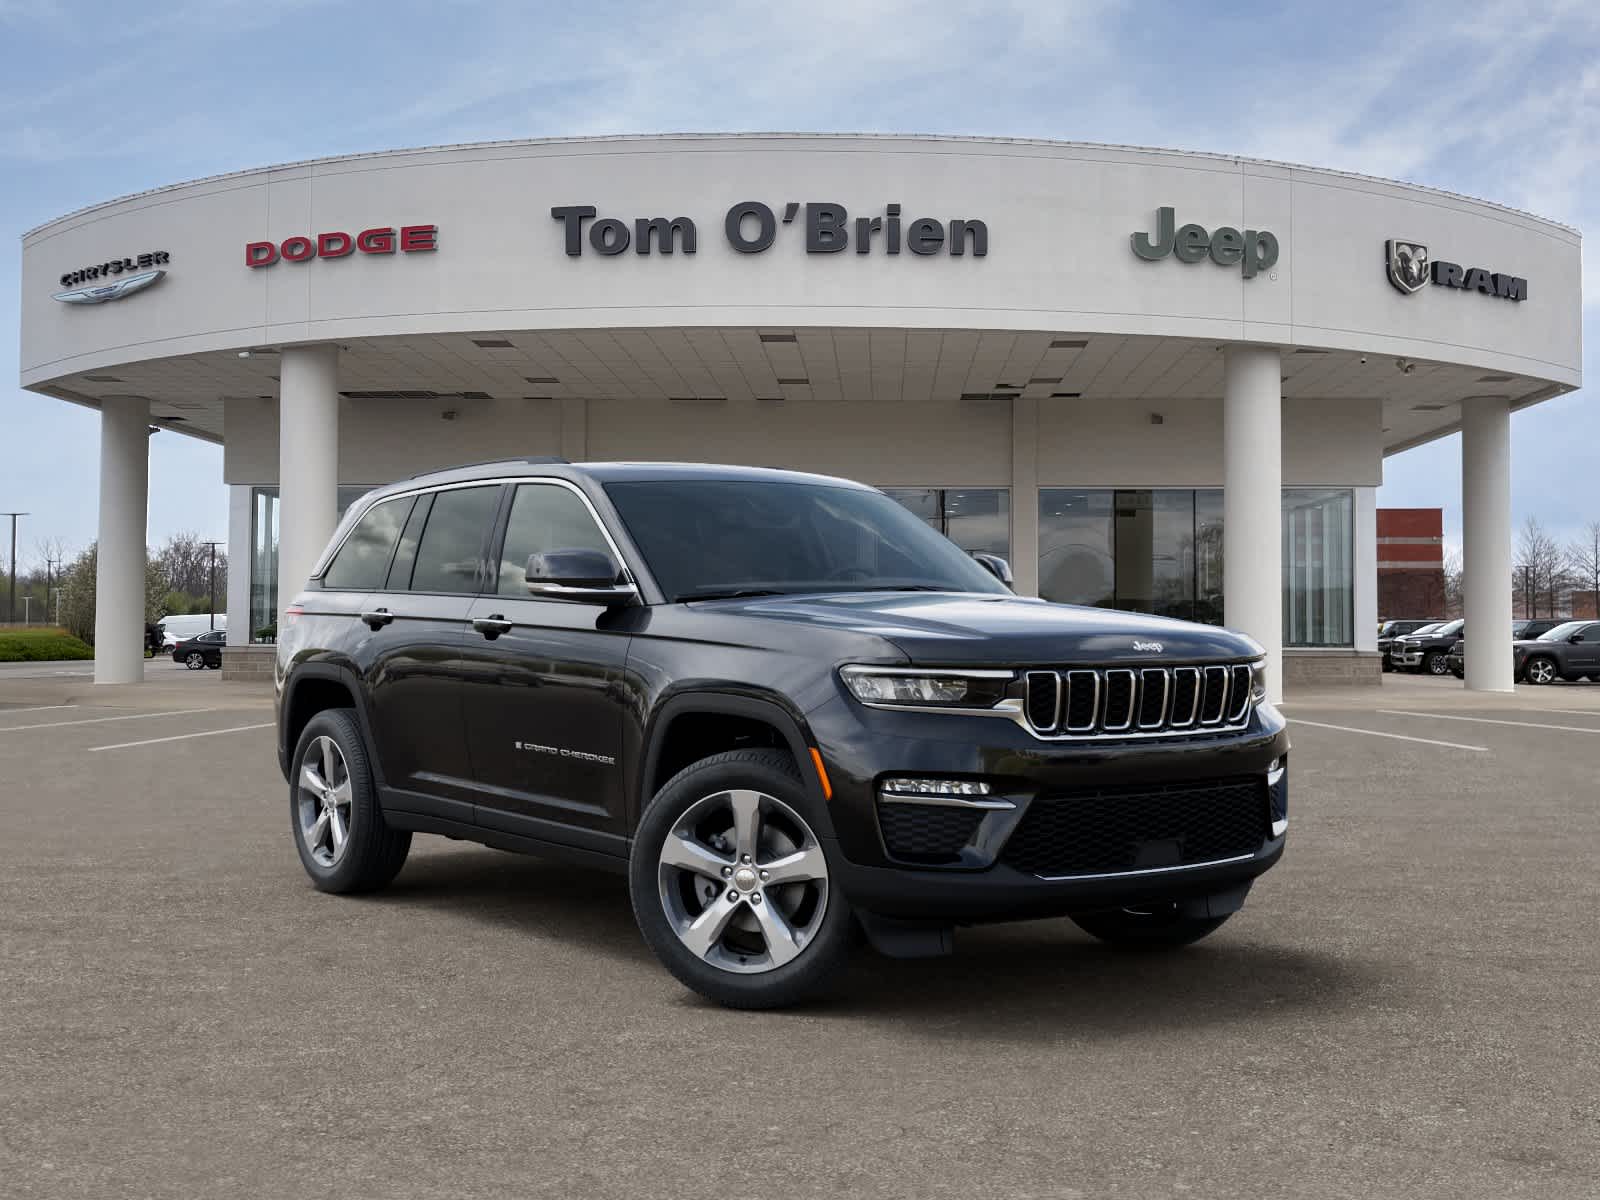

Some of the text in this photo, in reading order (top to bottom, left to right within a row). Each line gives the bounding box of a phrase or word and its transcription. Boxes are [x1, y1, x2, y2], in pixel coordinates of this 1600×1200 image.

[246, 225, 438, 268] DODGE
[551, 201, 988, 256] Tom O'Brien
[1131, 206, 1279, 279] Jeep
[60, 251, 169, 286] CHRYSLER
[1431, 260, 1527, 301] RAM
[1133, 641, 1163, 653] Jeep
[524, 743, 615, 765] GRAND CHEROKEE
